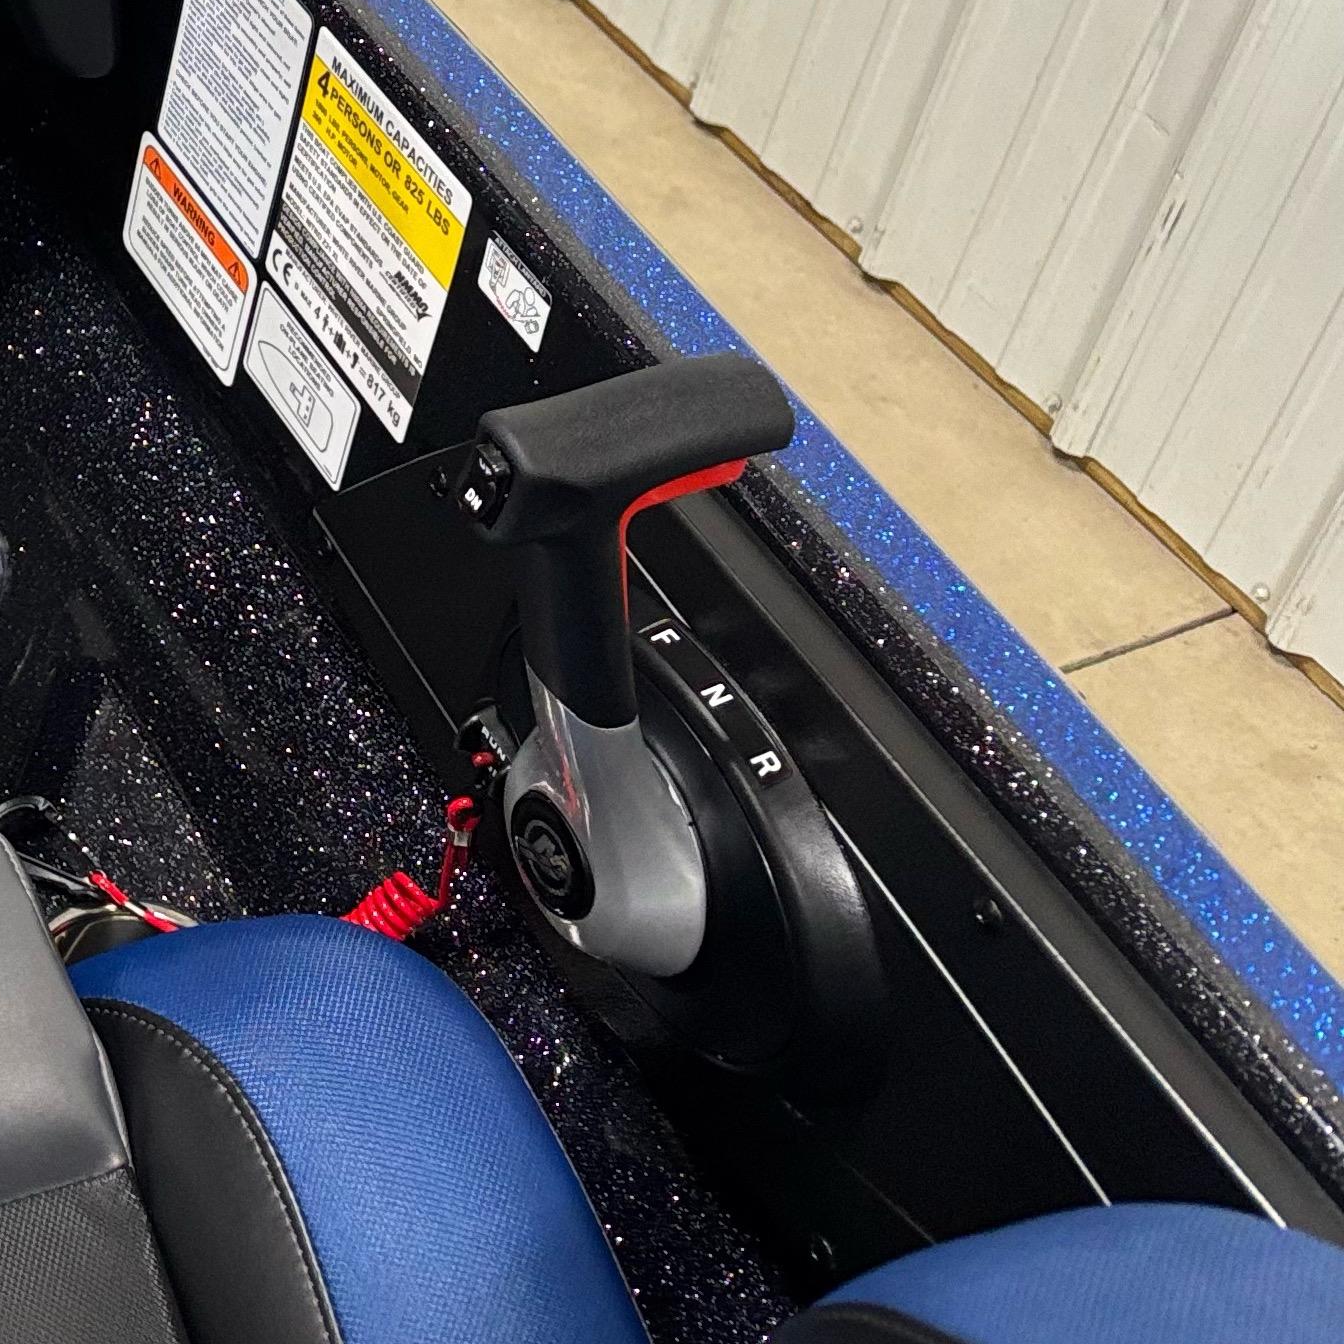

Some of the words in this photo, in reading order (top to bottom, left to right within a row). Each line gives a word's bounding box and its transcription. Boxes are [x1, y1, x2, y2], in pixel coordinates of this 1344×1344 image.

[315, 63, 333, 101] 4
[328, 84, 383, 158] PERSONS
[382, 147, 403, 180] OR
[403, 172, 425, 207] 825
[424, 197, 452, 238] LBS
[330, 54, 385, 127] MAXIMUM
[383, 116, 455, 207] CAPACITIES
[170, 180, 217, 249] WARNING
[312, 300, 322, 322] 4
[365, 370, 387, 406] 817
[385, 397, 402, 430] kg
[464, 487, 483, 512] DN
[650, 628, 681, 644] F
[700, 683, 734, 707] N
[749, 750, 782, 777] R
[481, 725, 506, 762] RUN
